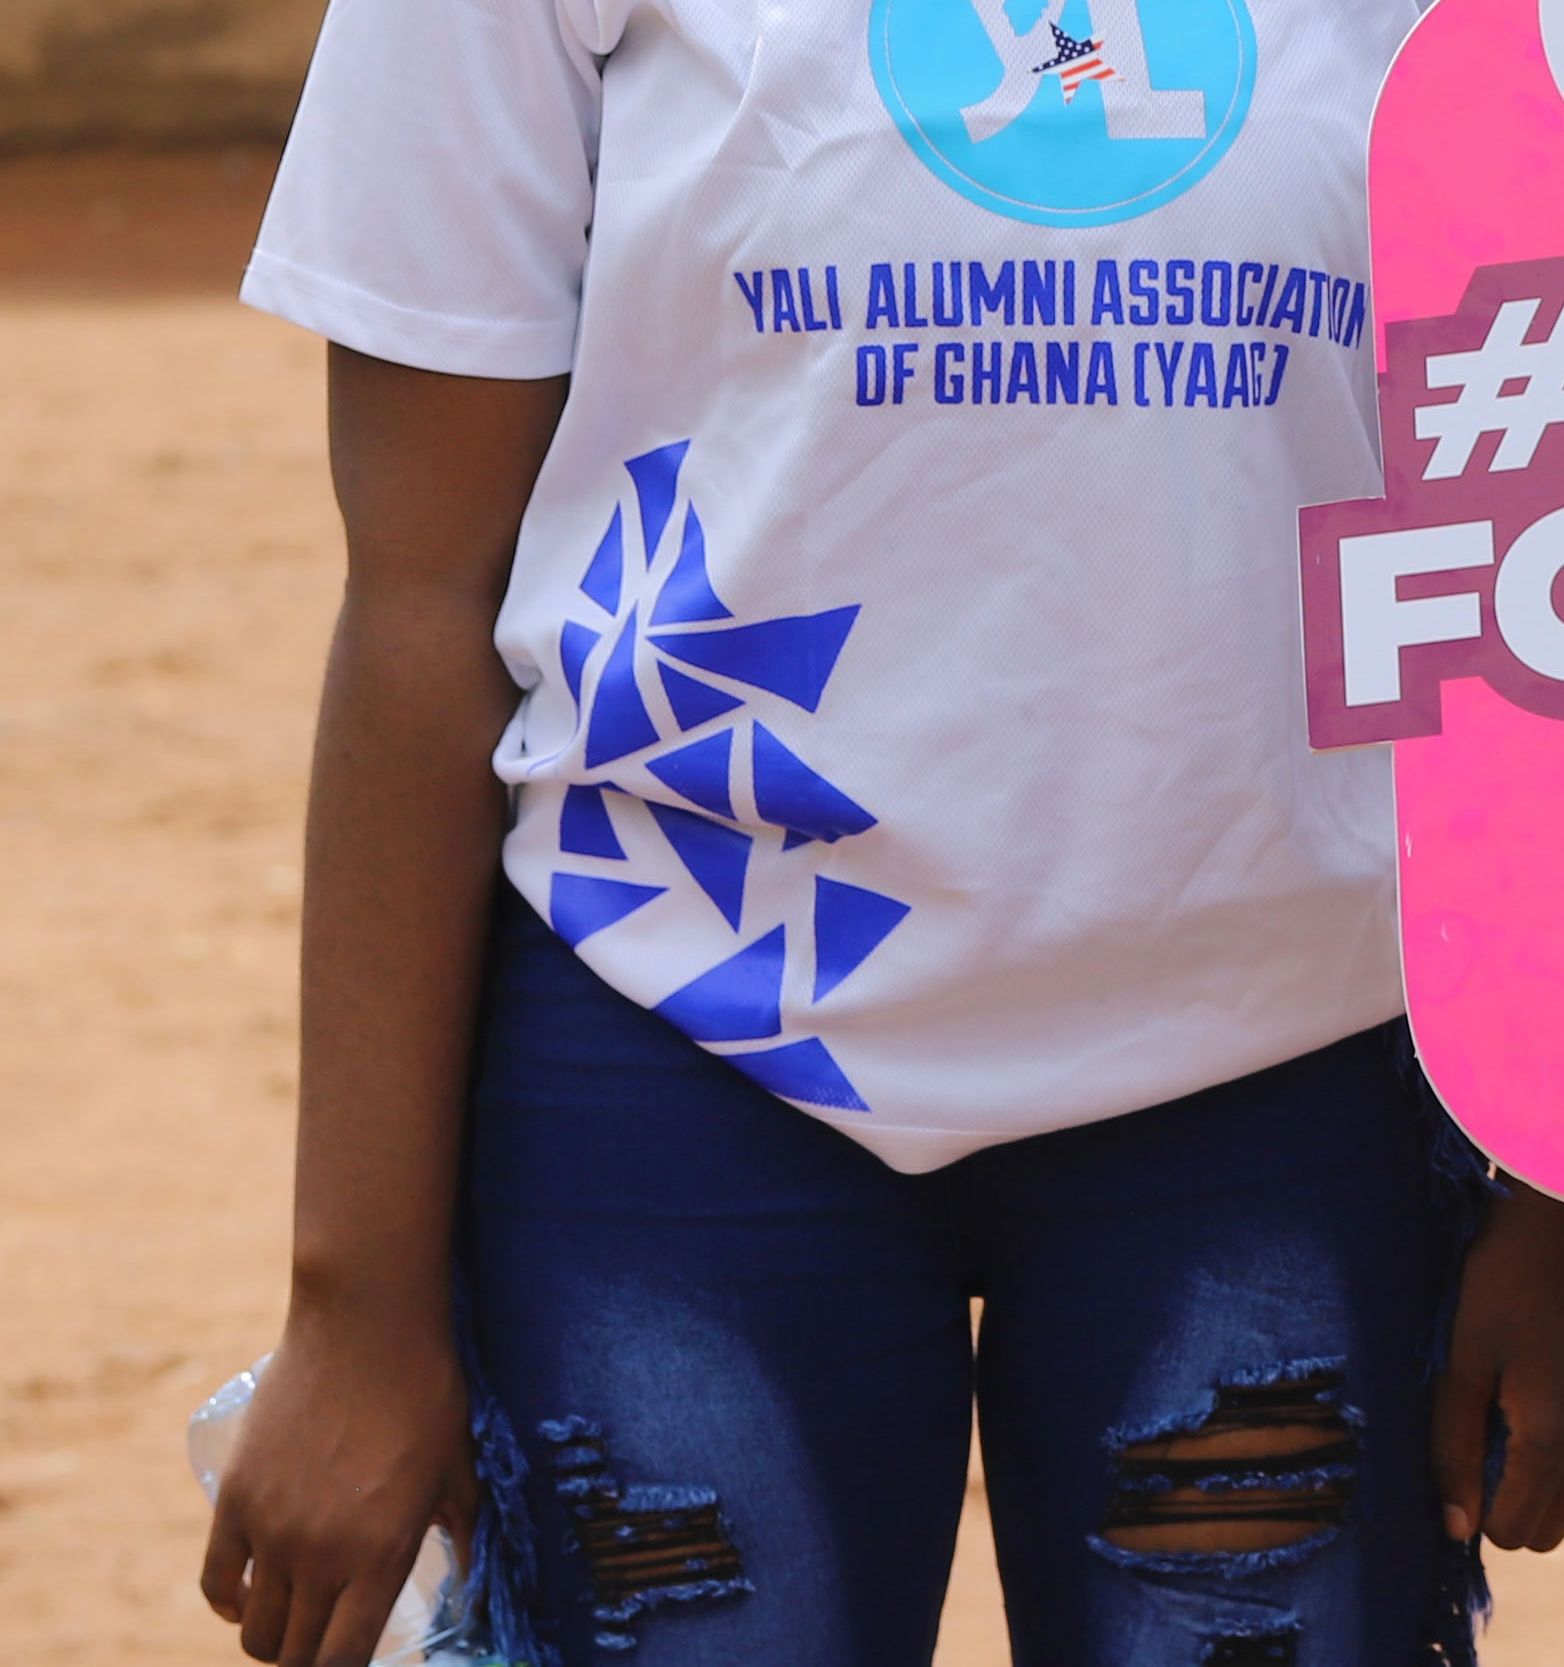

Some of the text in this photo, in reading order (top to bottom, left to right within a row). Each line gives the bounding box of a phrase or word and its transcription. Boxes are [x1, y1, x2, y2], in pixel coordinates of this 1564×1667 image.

[734, 259, 1366, 350] YALI ALUMNI ASSOCIATION
[855, 342, 918, 406] OF
[934, 341, 1118, 406] GHANA
